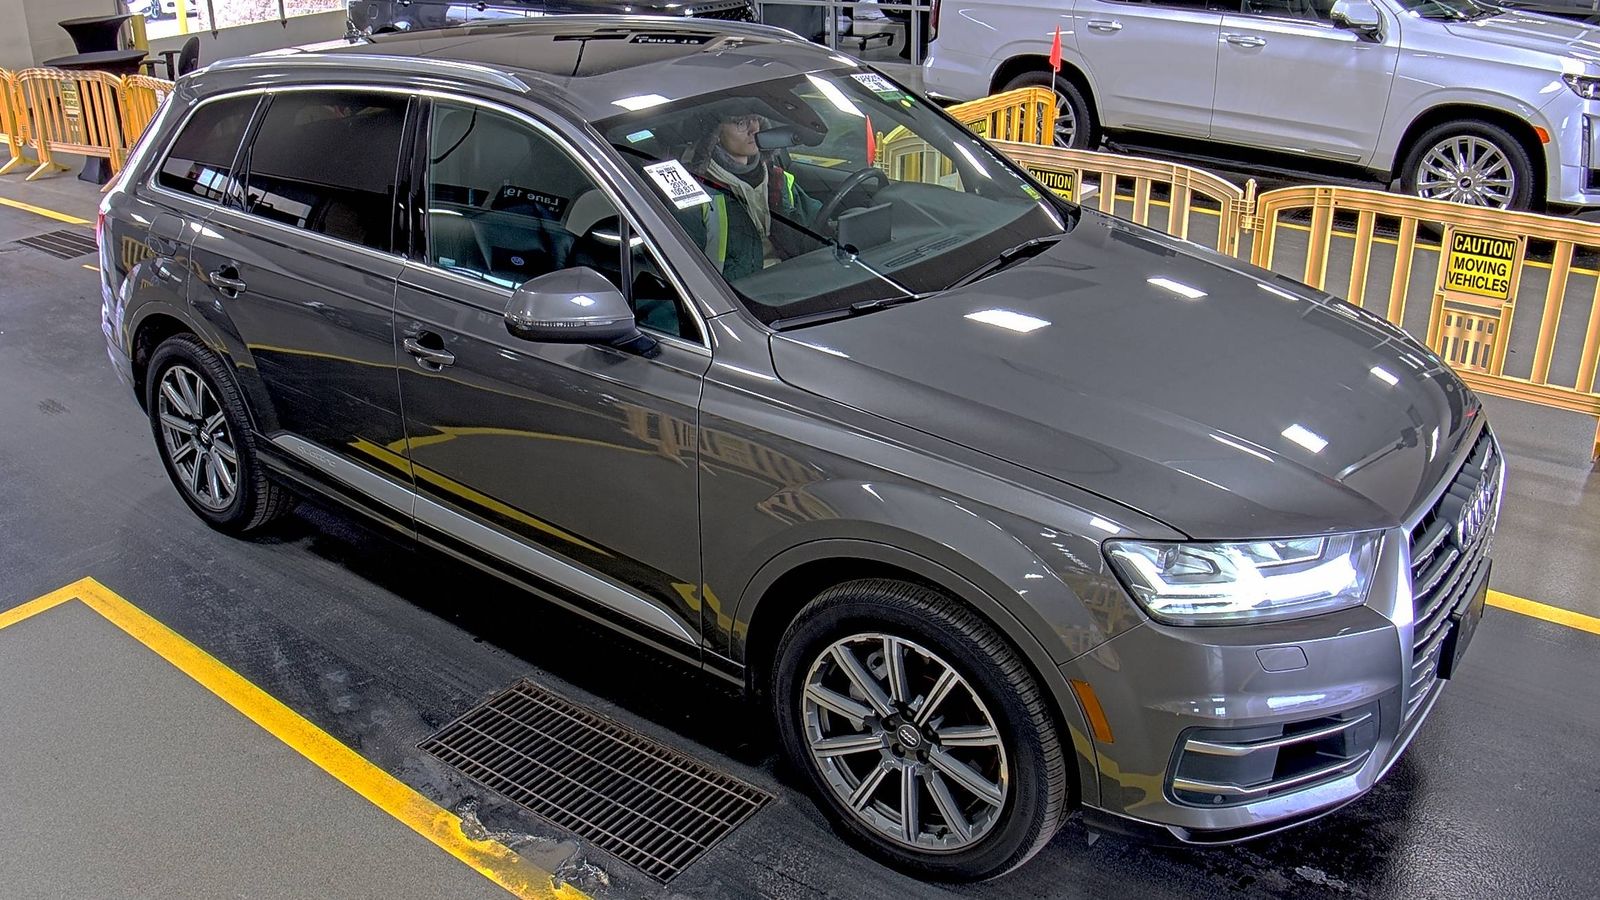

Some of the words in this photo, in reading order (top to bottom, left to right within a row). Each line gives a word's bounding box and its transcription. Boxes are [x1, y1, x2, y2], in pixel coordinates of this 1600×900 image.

[1454, 235, 1513, 258] CAUTION
[1454, 256, 1507, 277] MOVING
[1448, 271, 1508, 293] VEHICLES
